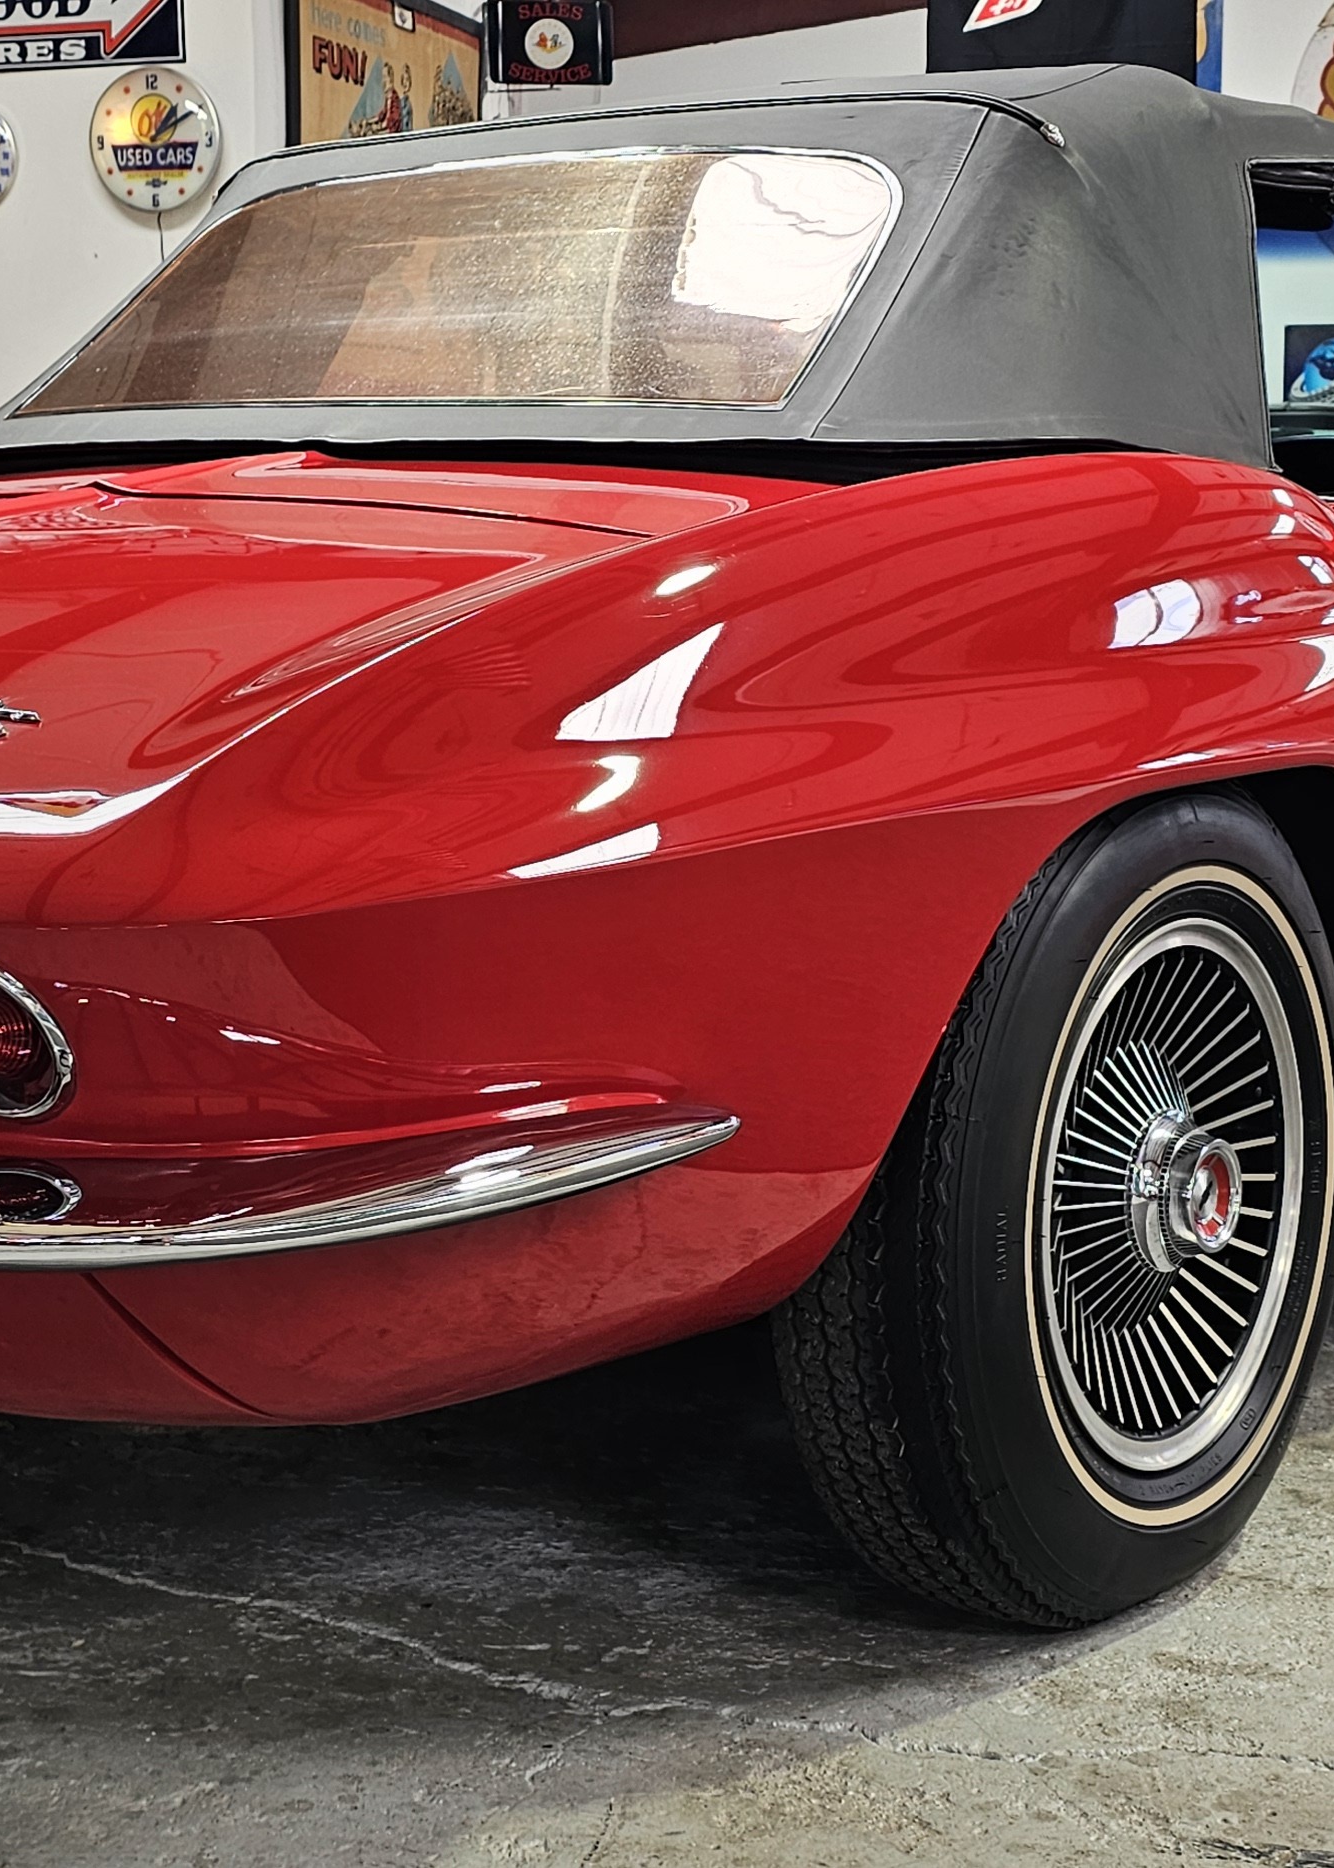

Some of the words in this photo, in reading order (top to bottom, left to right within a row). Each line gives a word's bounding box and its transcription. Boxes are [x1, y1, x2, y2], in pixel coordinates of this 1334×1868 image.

[518, 3, 584, 20] SALES
[312, 34, 367, 87] FUN!
[145, 74, 158, 91] 12
[508, 61, 592, 83] SERVICE
[117, 148, 153, 167] USED
[156, 146, 194, 165] CARS
